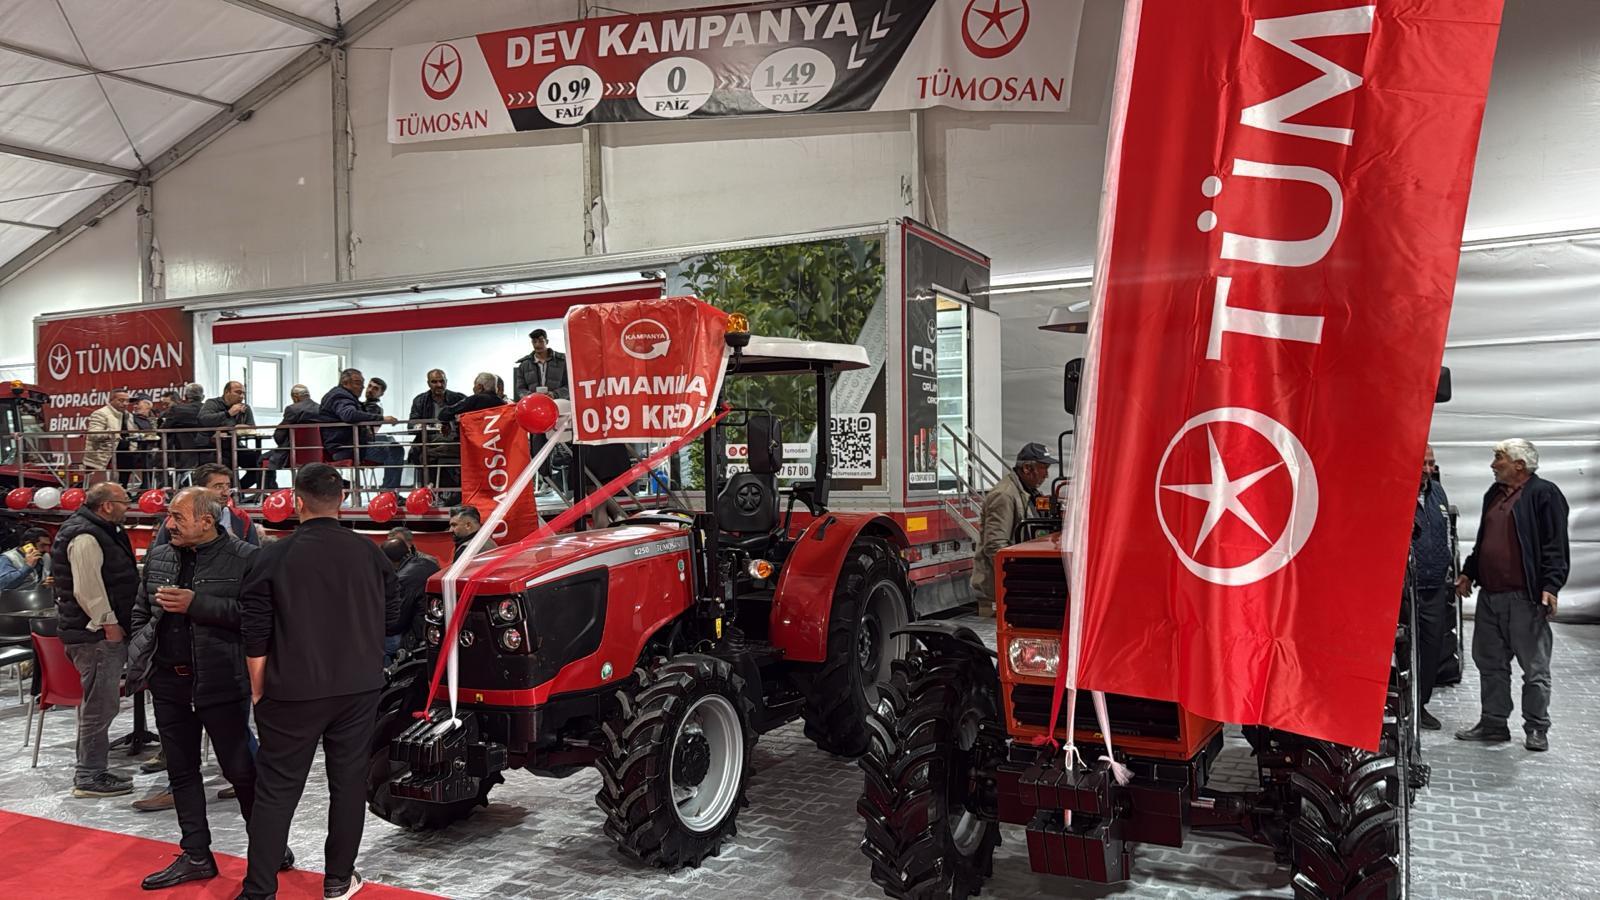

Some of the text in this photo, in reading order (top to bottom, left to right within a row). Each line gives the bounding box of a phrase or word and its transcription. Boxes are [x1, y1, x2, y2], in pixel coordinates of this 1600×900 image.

[507, 2, 859, 69] DEV KAMPANYA
[666, 66, 687, 93] 0
[765, 61, 816, 87] 1,49
[917, 68, 1065, 101] TÜMOSAN
[547, 77, 591, 104] 0,99
[771, 88, 809, 105] FAİZ
[555, 105, 584, 119] FAİZ
[655, 98, 690, 112] FAİZ
[396, 109, 488, 137] TÜMOSAN
[625, 333, 667, 341] KAMPANYA
[75, 341, 183, 375] TÜMOSAN
[911, 345, 938, 373] CR
[50, 388, 110, 409] TOPRAĞIN
[50, 413, 90, 432] BİRLİK
[787, 466, 797, 476] 67
[799, 465, 809, 475] 00
[634, 546, 649, 556] 4250
